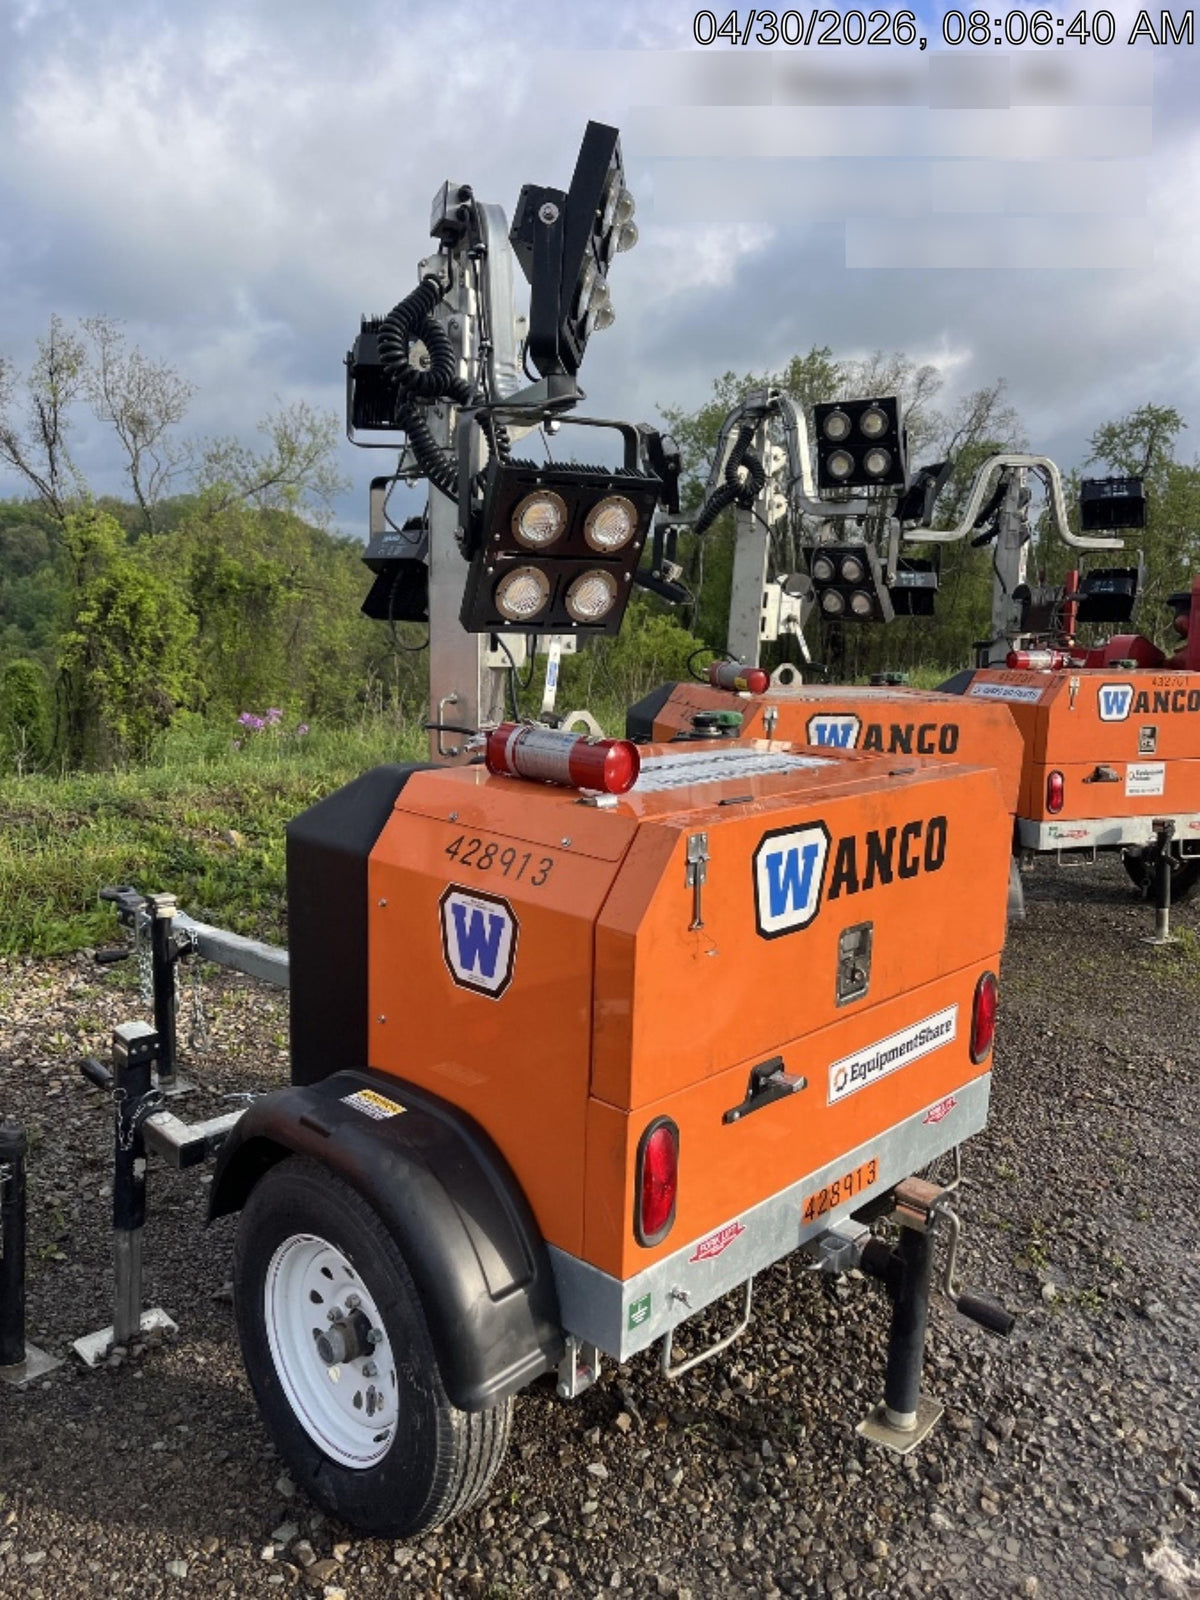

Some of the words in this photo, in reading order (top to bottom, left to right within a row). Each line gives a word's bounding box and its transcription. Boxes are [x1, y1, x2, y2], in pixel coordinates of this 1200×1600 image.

[1102, 688, 1200, 716] WANCO
[815, 723, 960, 755] WANCO
[445, 835, 554, 886] 428913
[764, 815, 948, 919] WANCO
[451, 903, 505, 978] W
[849, 1019, 953, 1083] EquipmentShare
[803, 1158, 877, 1221] 428913
